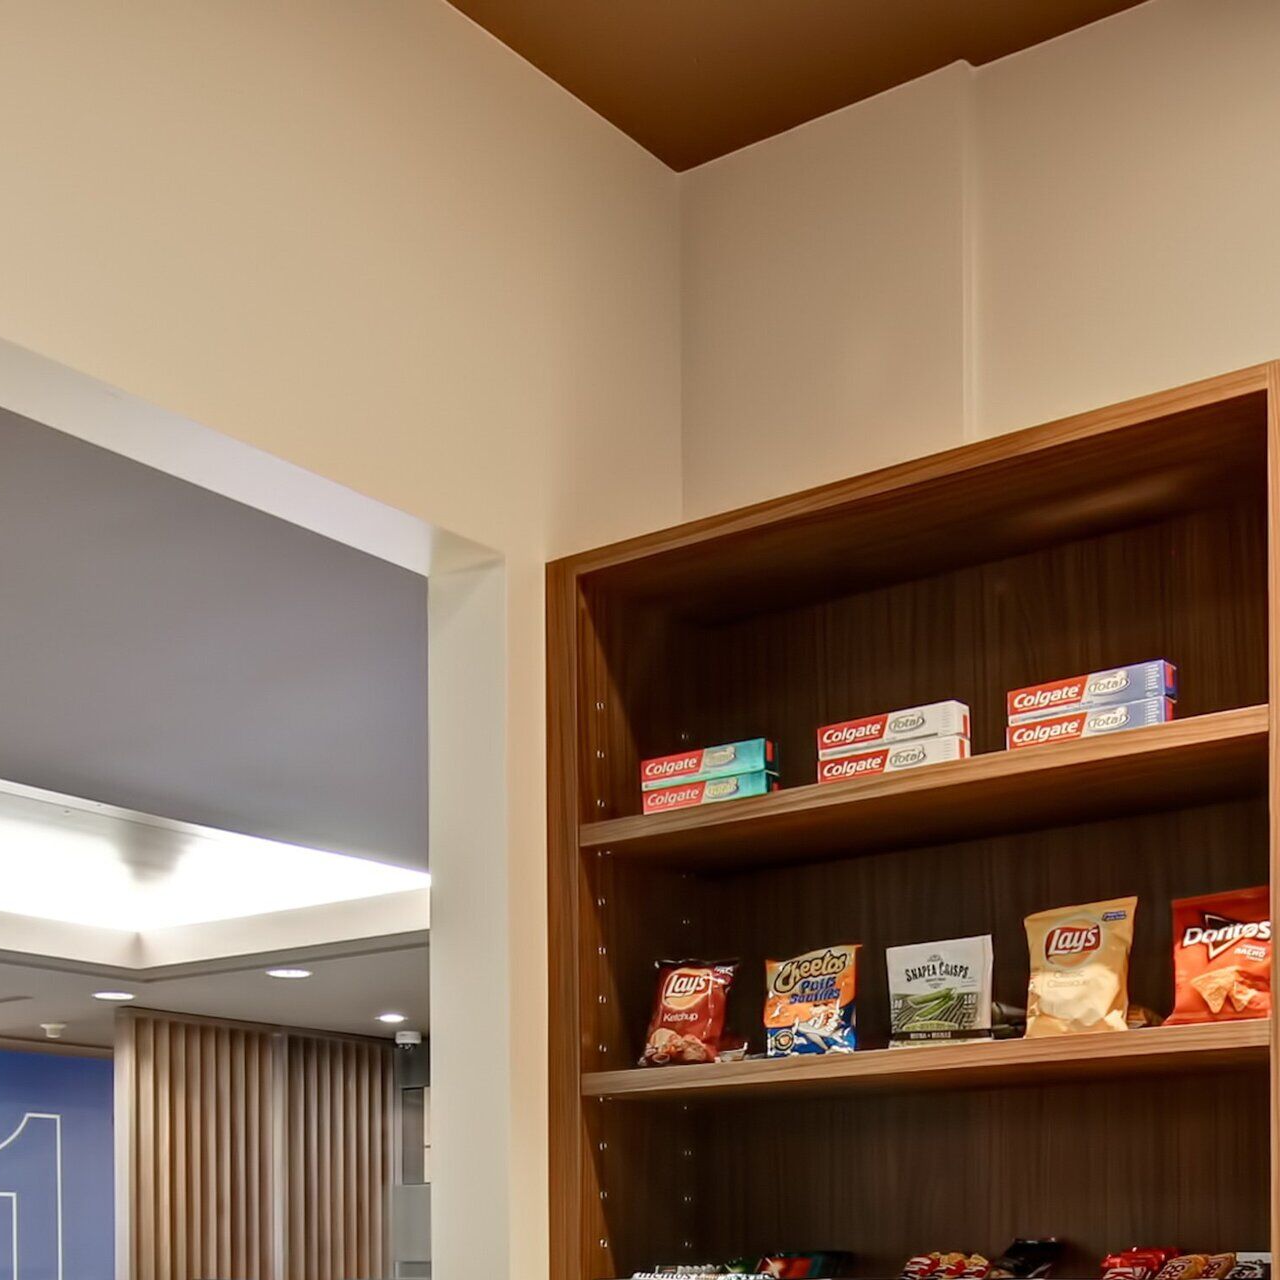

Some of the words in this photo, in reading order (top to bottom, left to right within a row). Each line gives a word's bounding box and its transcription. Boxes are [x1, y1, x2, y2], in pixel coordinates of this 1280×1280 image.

[1013, 686, 1079, 709] Colgate
[1091, 677, 1125, 691] Total
[822, 724, 881, 744] Colgate
[892, 716, 922, 729] Total
[1012, 721, 1079, 744] Colgate
[1091, 713, 1125, 727] Total
[645, 757, 697, 776] Colgate
[822, 758, 881, 777] Colgate
[893, 750, 923, 763] Total
[647, 788, 699, 807] Colgate
[1182, 920, 1271, 948] Doritos
[774, 950, 848, 993] Cheetos
[662, 1010, 700, 1023] Ketchup
